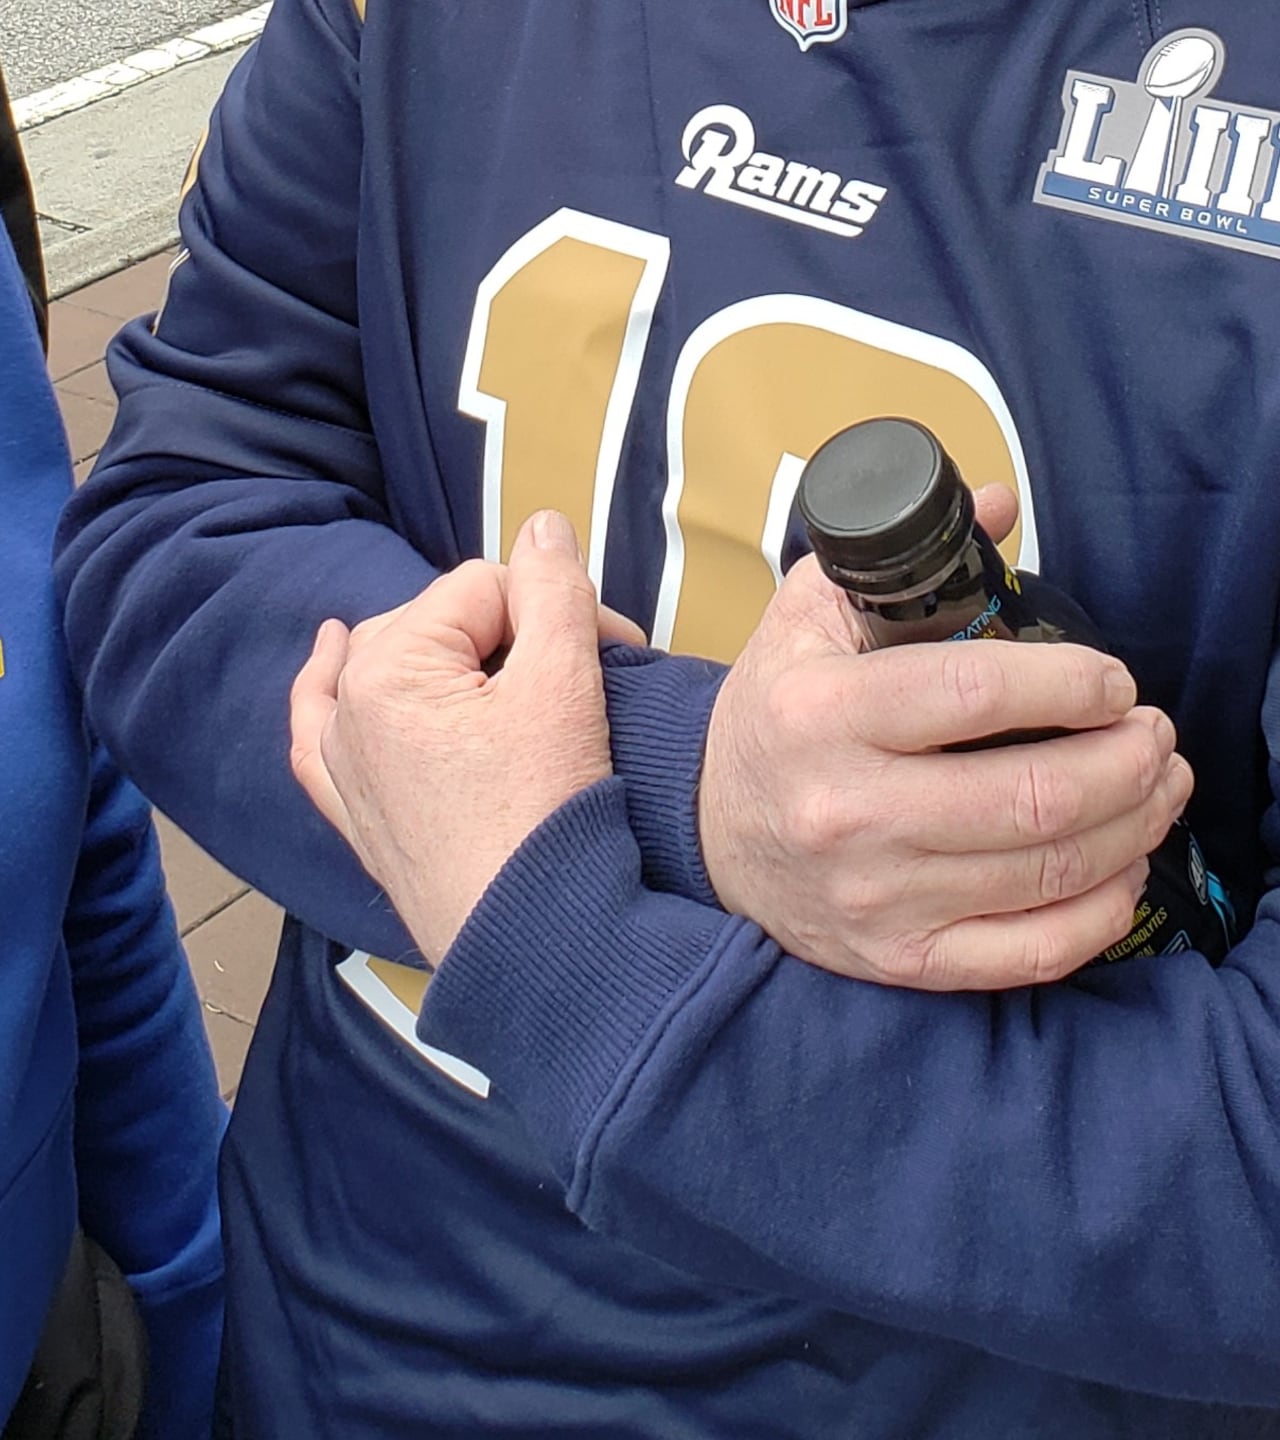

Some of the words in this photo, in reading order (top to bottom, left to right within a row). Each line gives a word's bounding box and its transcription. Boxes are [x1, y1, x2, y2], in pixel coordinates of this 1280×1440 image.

[674, 104, 888, 238] Rams
[1088, 184, 1171, 220] SUPER
[1179, 205, 1250, 236] BOWL
[1104, 906, 1168, 961] ELECTROLYTES
